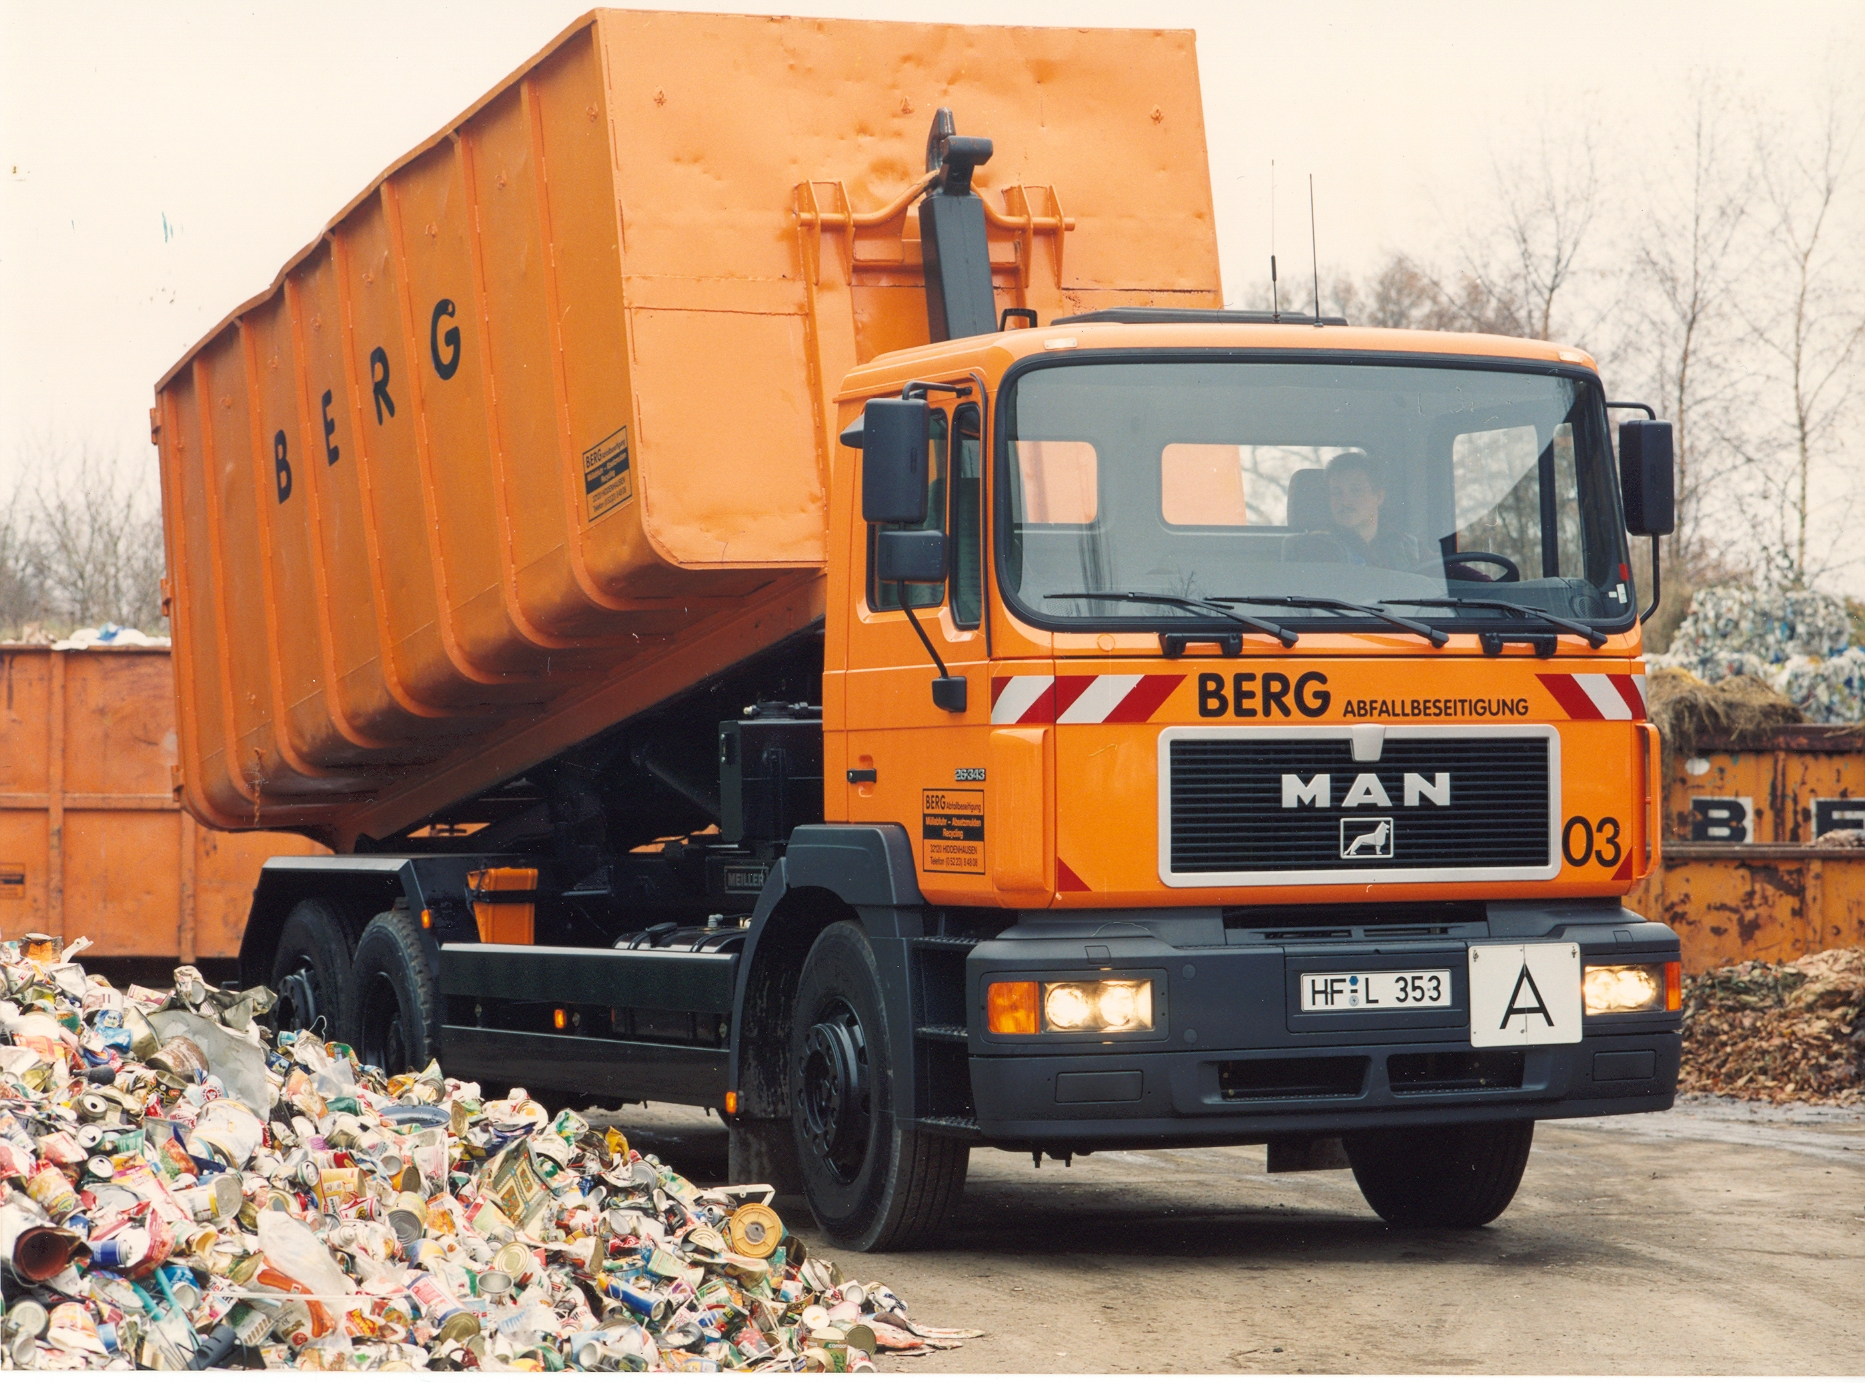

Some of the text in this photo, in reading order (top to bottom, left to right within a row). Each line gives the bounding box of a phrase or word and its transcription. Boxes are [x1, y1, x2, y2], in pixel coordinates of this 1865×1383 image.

[274, 298, 462, 505] BERG
[586, 449, 602, 468] BERG
[1198, 670, 1530, 719] BERG ABFALLBESEITIGUNG
[926, 795, 945, 810] BERG
[1281, 772, 1451, 809] MAN
[1561, 815, 1622, 868] 03
[1394, 975, 1442, 1003] 353
[1498, 962, 1556, 1030] A
